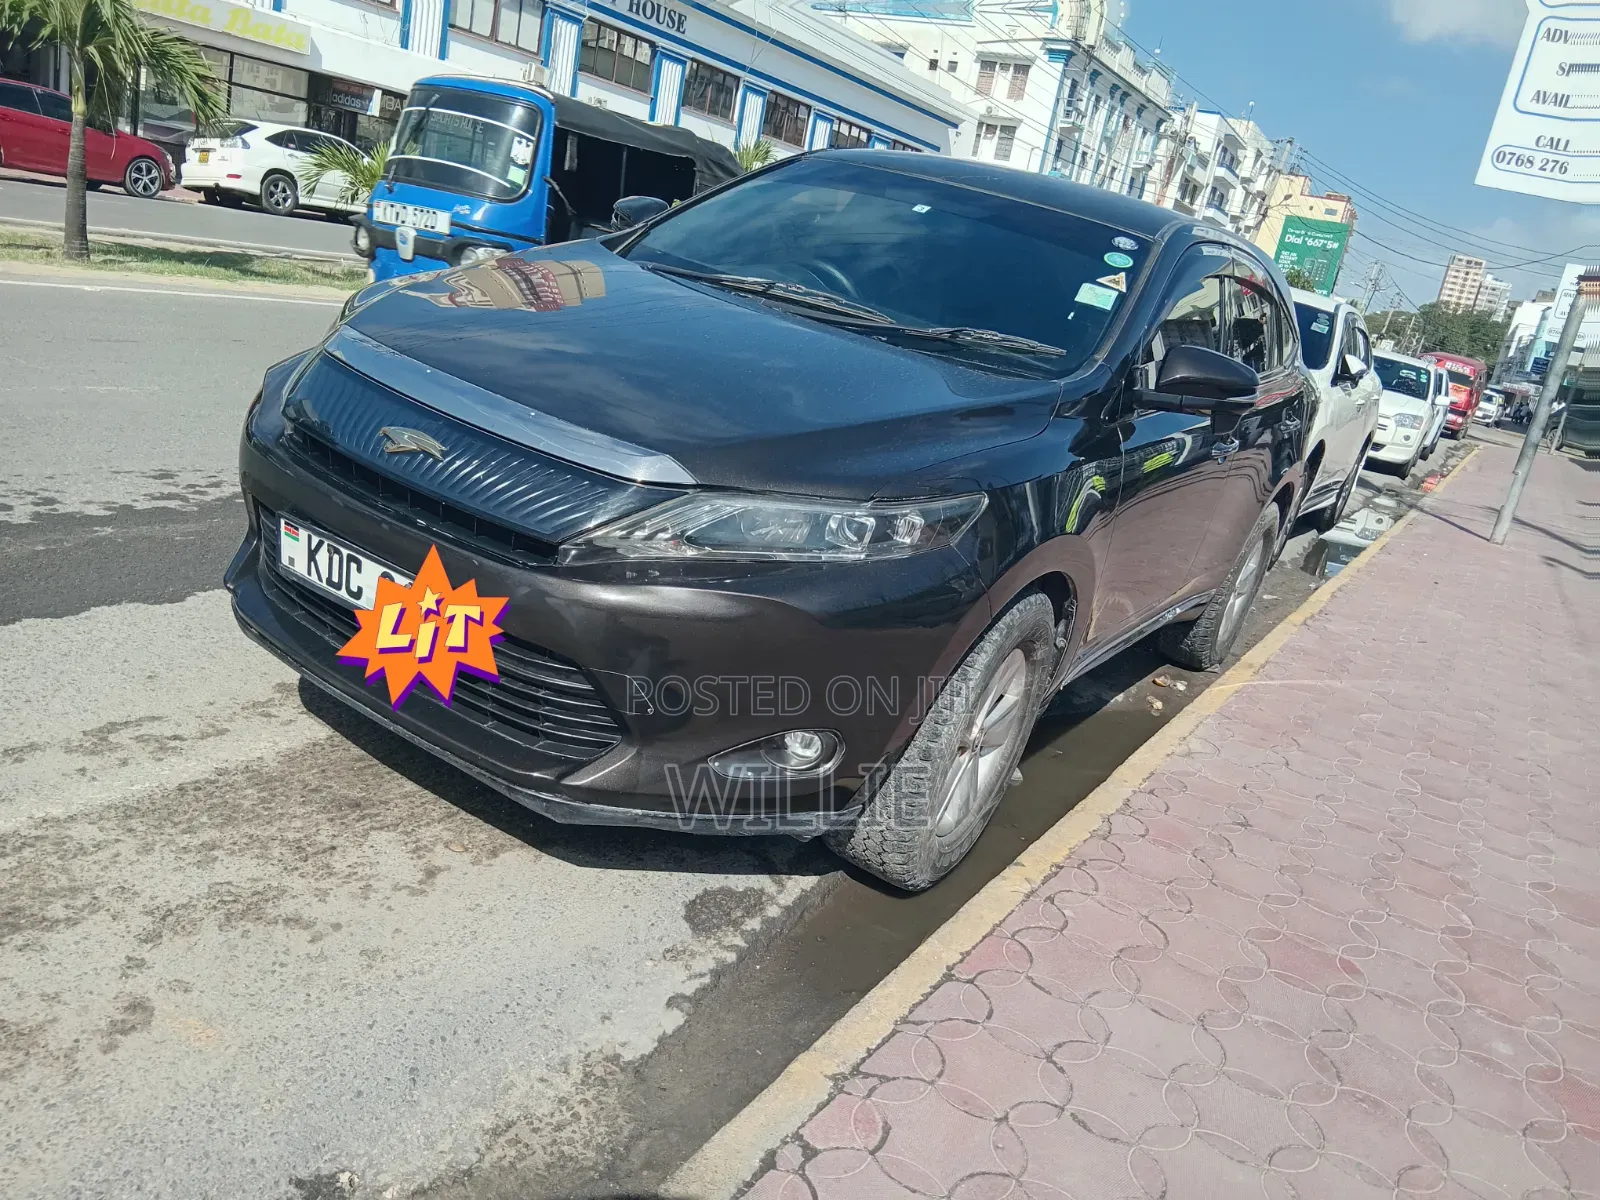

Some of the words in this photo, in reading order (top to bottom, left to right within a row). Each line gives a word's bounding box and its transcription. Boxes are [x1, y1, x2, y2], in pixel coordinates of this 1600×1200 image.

[135, 0, 212, 25] ata
[223, 8, 307, 50] Bata
[628, 0, 688, 35] HOUSE
[332, 93, 361, 108] adidas
[1535, 134, 1572, 153] CALL
[1495, 150, 1535, 170] 0768
[1538, 157, 1570, 175] 276
[1285, 234, 1303, 244] Dial
[306, 533, 364, 601] KDC
